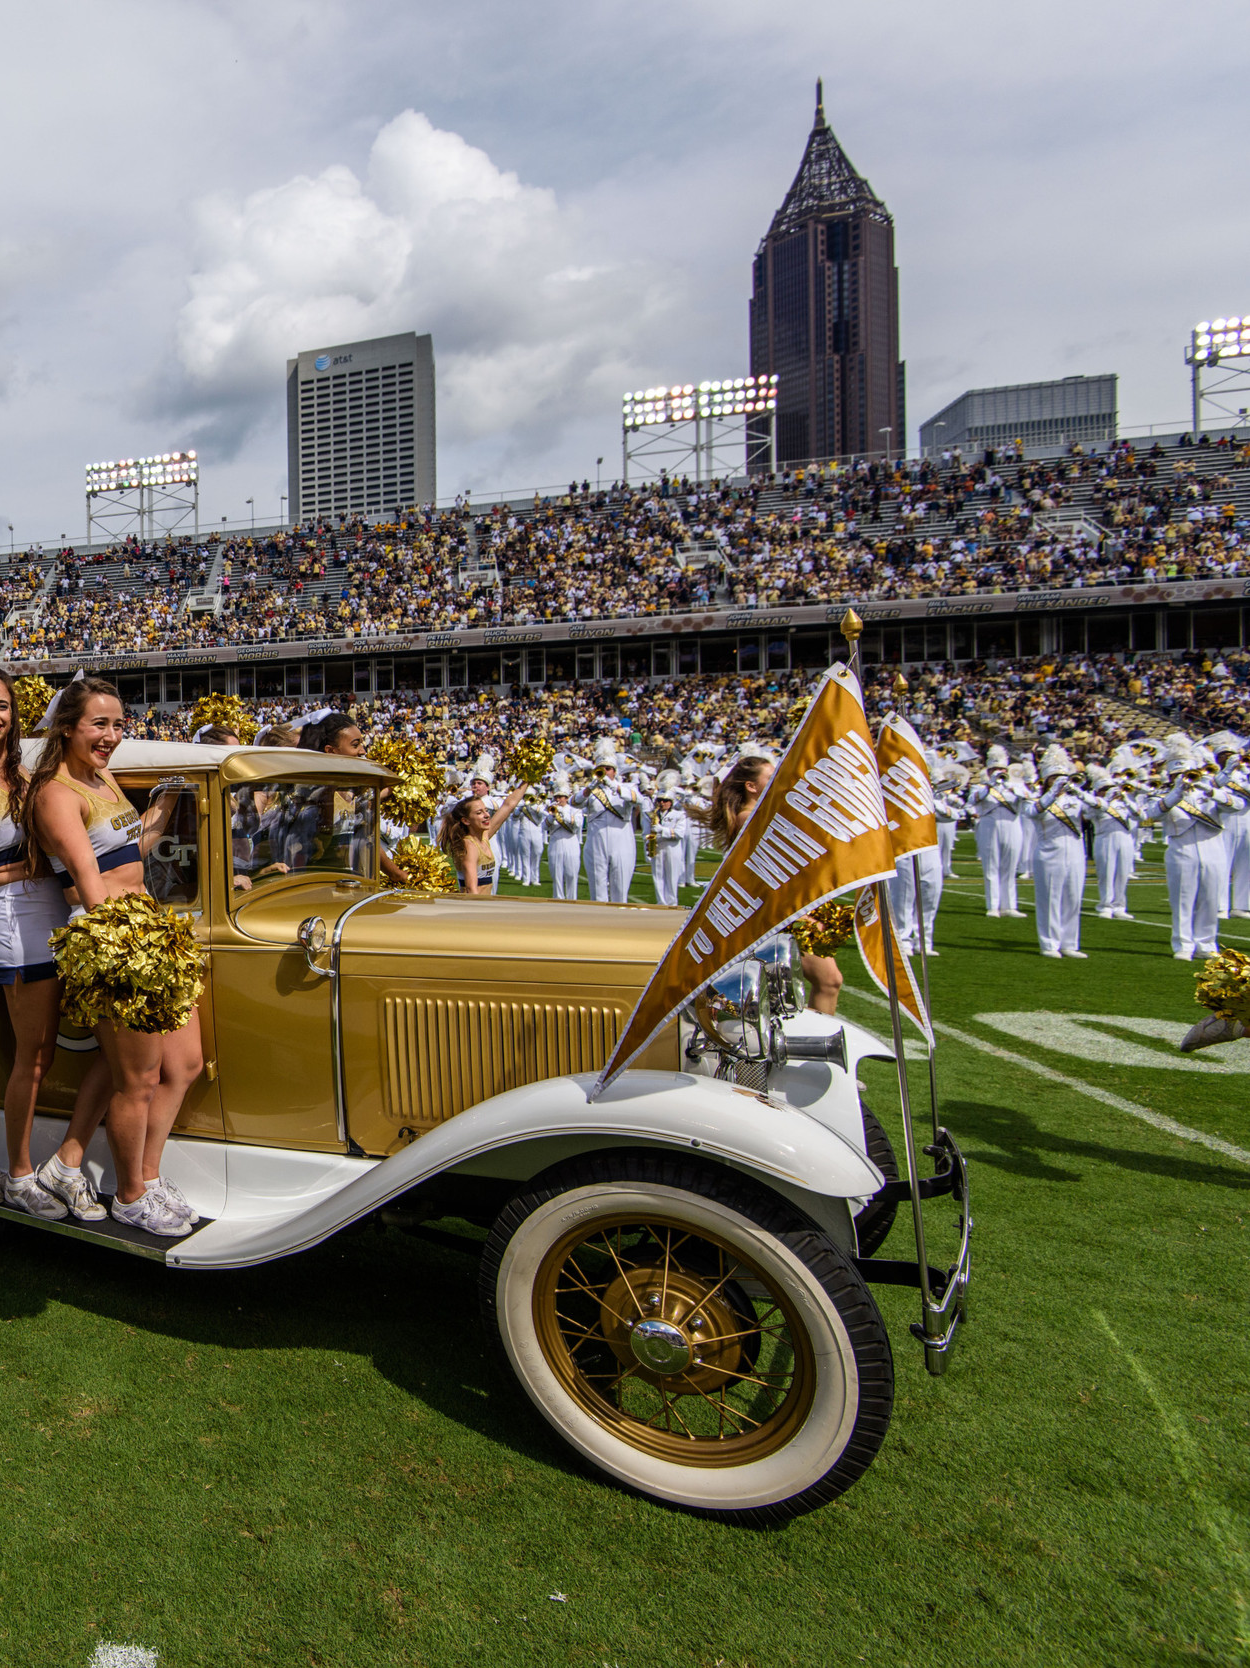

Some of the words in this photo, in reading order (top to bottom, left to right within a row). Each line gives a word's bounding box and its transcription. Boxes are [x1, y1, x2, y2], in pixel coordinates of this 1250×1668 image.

[1017, 593, 1062, 601] WILLIAM
[1014, 596, 1110, 611] ALEXANDER
[826, 605, 867, 614] EVETT
[926, 603, 994, 616] FINCHER
[726, 616, 792, 629] HEISMAN
[727, 613, 752, 621] JOHN
[426, 634, 450, 642] PETER
[484, 629, 506, 637] BUCK
[484, 632, 542, 644] FLOWERS
[569, 628, 615, 639] GUYON
[353, 641, 411, 653] HAMILTON
[427, 638, 461, 648] PUND
[236, 646, 264, 654] GEORGE
[237, 650, 279, 661] MORRIS
[308, 646, 342, 656] DAVIS
[69, 662, 96, 672] HALL
[99, 661, 114, 670] OF
[116, 659, 148, 669] FAME
[166, 655, 217, 666] BAUGHAN
[152, 834, 198, 867] GT
[684, 924, 715, 964] TO
[705, 876, 764, 938] HELL
[744, 812, 828, 891] WITH
